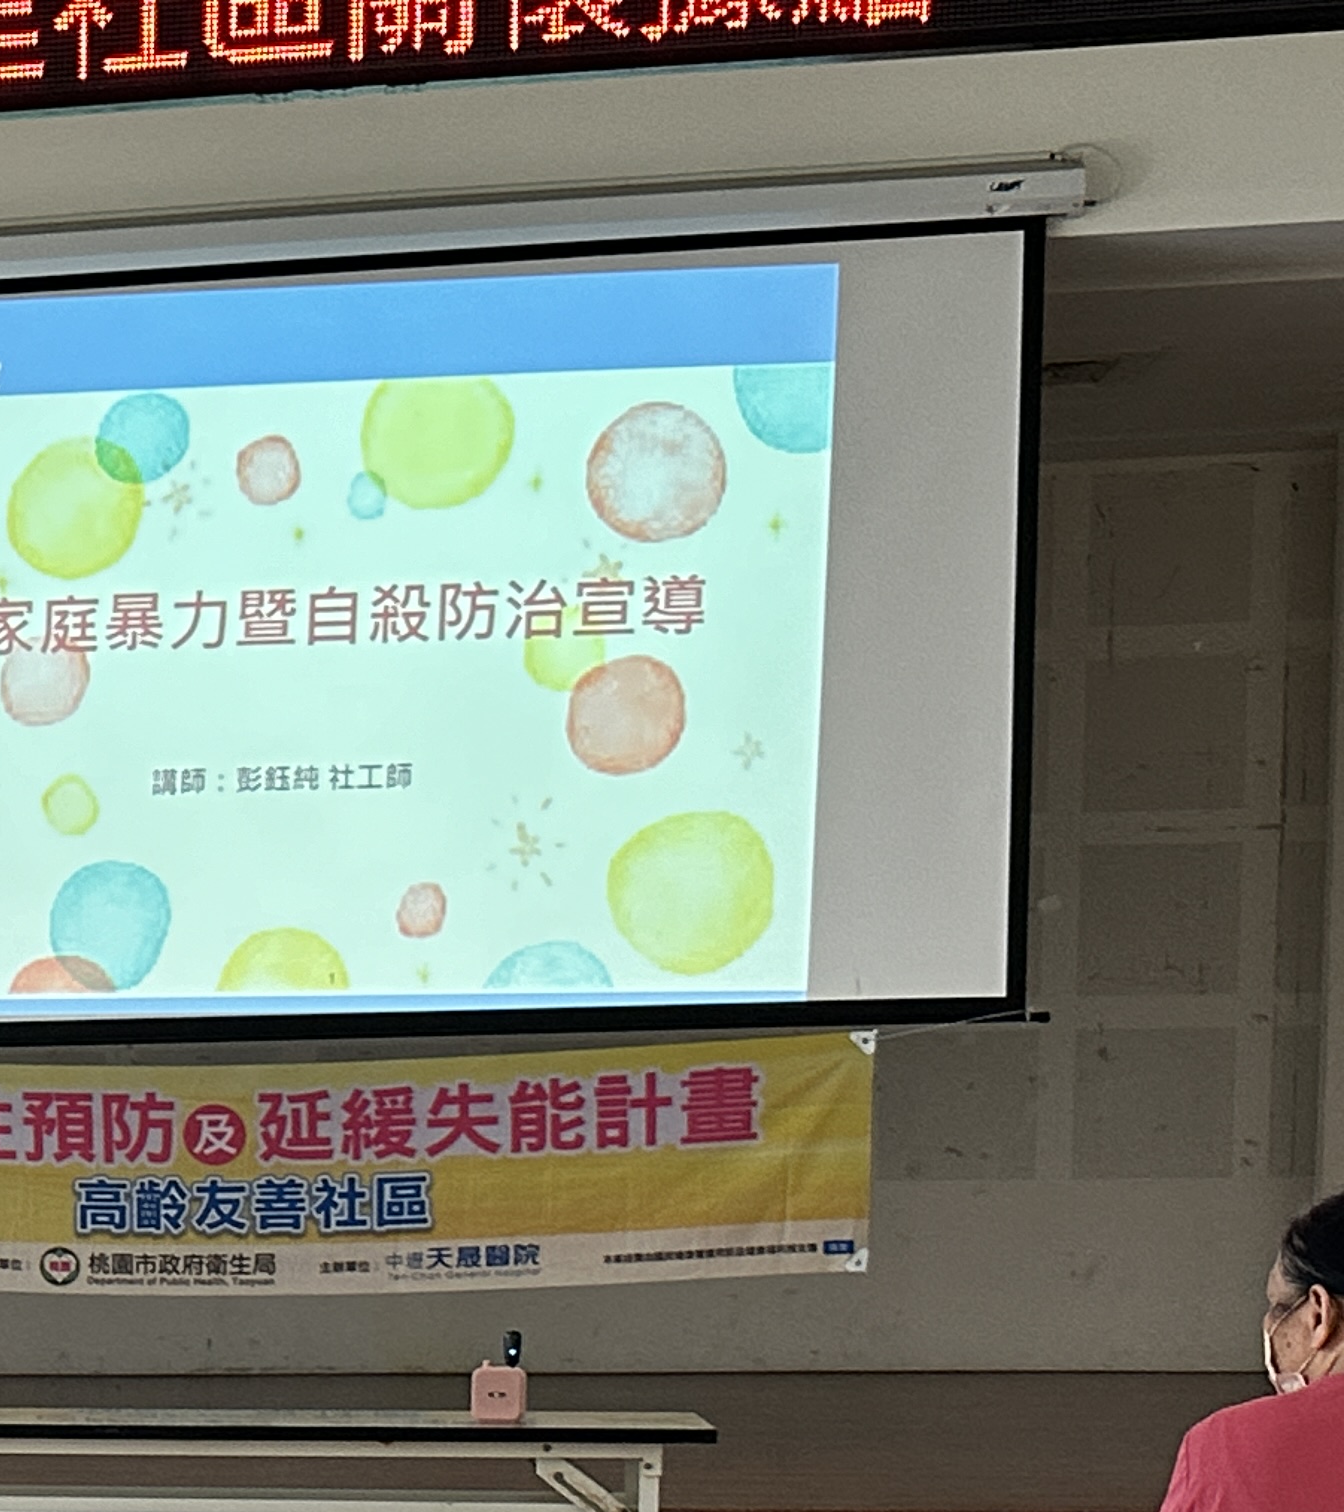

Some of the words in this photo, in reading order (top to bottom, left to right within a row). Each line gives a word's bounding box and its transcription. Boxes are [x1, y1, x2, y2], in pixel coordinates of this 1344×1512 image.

[328, 762, 413, 790] 社工師
[75, 1173, 432, 1232] 高齡友善社區
[88, 1252, 276, 1276] 桃園市政府衛生局
